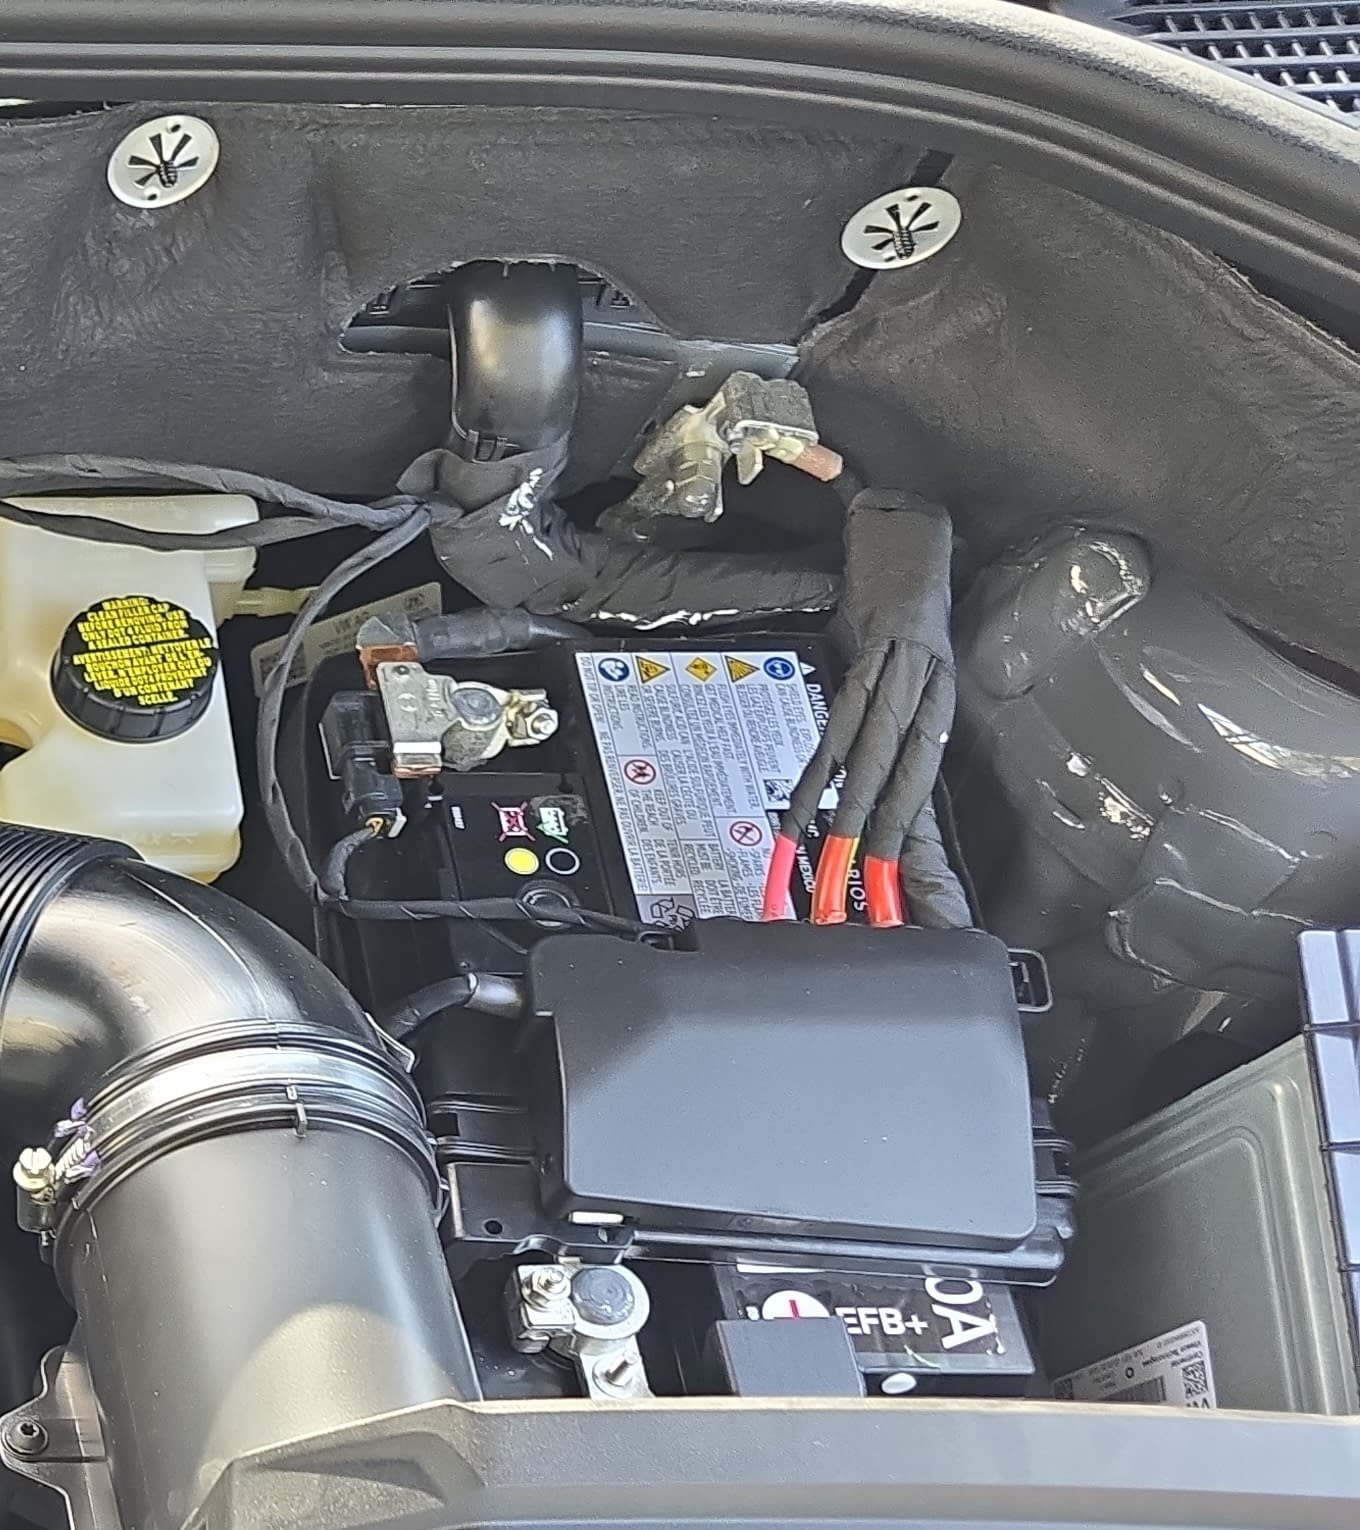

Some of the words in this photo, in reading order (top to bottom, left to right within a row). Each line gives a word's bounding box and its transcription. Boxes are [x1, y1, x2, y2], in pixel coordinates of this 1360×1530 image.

[86, 610, 118, 621] CLEAN
[118, 606, 151, 616] FILLER
[150, 602, 169, 613] CAP
[101, 597, 149, 609] WARNING:
[77, 619, 115, 631] BEFORE
[165, 609, 186, 620] USE
[81, 630, 107, 640] ONLY
[107, 627, 125, 638] DOT
[126, 626, 133, 635] 4
[133, 623, 161, 633] FLUID
[161, 620, 189, 629] FROM
[87, 640, 95, 650] A
[95, 637, 131, 648] SEALED
[150, 640, 199, 653] NETTOYER
[198, 637, 211, 648] LE
[85, 660, 131, 672] BOUCHON
[131, 655, 162, 666] AVANT
[165, 652, 178, 662] DE
[177, 658, 197, 670] QUE
[198, 656, 212, 667] DU
[94, 678, 130, 689] LIQUIDE
[155, 667, 207, 680] PROVENANT
[137, 679, 194, 693] CONTENANT
[653, 839, 667, 848] DE
[694, 843, 709, 860] MUST
[656, 850, 669, 858] LA
[707, 843, 724, 870] BATTERY
[699, 862, 711, 870] BE
[796, 857, 816, 893] MEXICO
[703, 879, 720, 895] DOIT
[846, 868, 869, 912] RIOS
[720, 891, 736, 914] BATTER
[836, 1306, 928, 1337] EFB+
